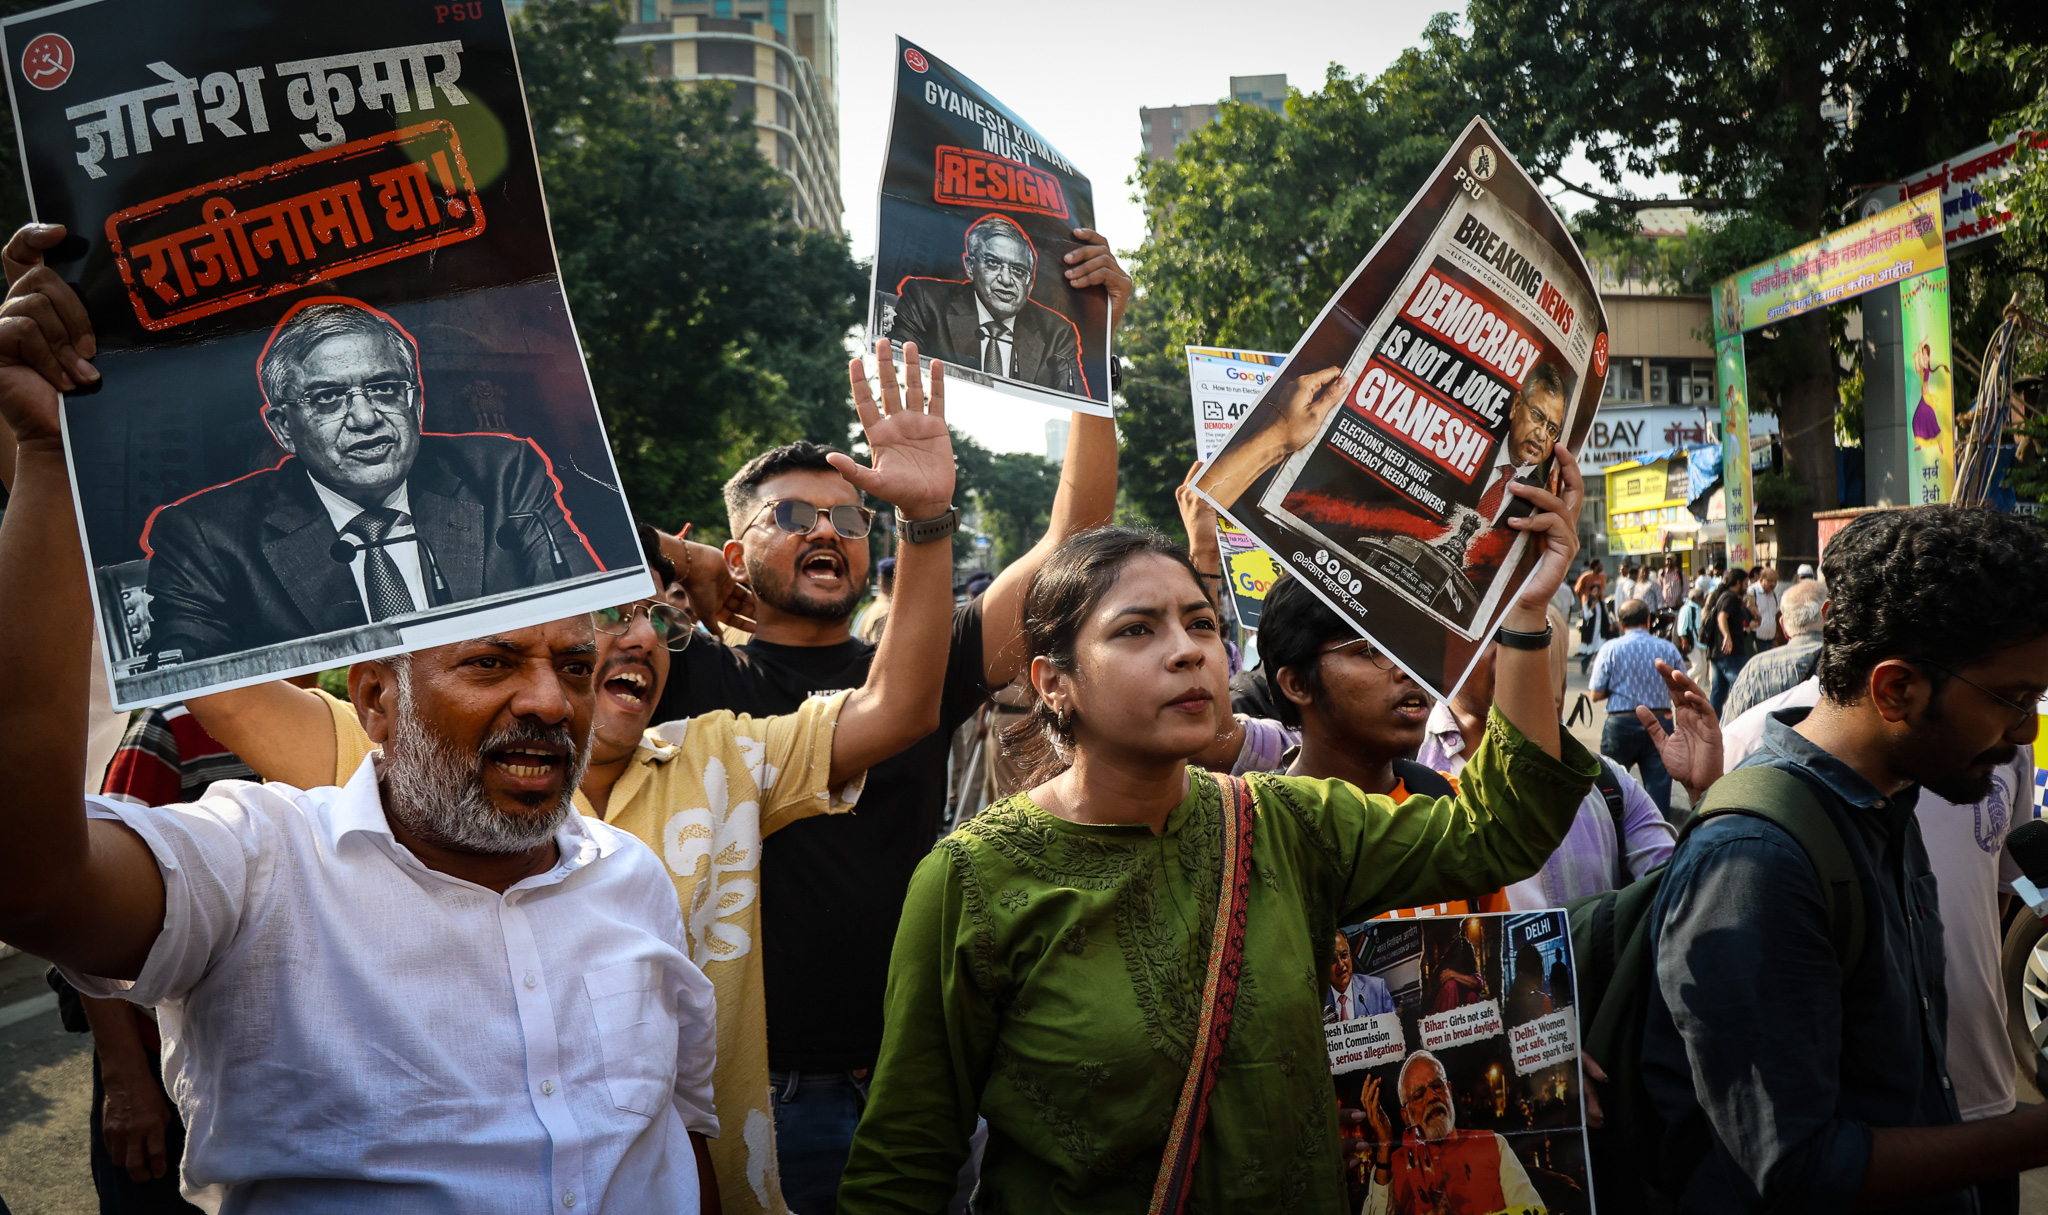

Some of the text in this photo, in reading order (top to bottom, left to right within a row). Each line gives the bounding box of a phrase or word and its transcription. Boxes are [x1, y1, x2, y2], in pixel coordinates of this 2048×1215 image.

[435, 2, 484, 23] PSU
[65, 39, 471, 180] ज्ञानेश कुमार
[925, 80, 1010, 140] GYANESH
[983, 127, 1032, 168] MUST
[943, 154, 1061, 211] RESIGN
[1453, 166, 1485, 200] PSU
[129, 179, 376, 305] राजीनामा
[1453, 212, 1575, 335] BREAKING NEWS
[1483, 273, 1520, 304] COMMISSION
[1521, 303, 1529, 311] OF
[1530, 311, 1545, 326] INDIA
[1767, 300, 1791, 320] आपले
[1815, 284, 1845, 305] स्वागत
[1846, 271, 1875, 295] करीत
[1406, 273, 1541, 385] DEMOCRACY
[1226, 367, 1271, 385] Google
[1380, 325, 1511, 429] IS NOT A JOKE,
[1204, 422, 1235, 430] DEMOCRA
[1355, 366, 1490, 478] GYANESH!
[1588, 420, 1645, 449] BAY
[1338, 417, 1433, 487] ELECTIONS NEED TRUST.
[1594, 450, 1647, 463] MATTRES
[1330, 431, 1447, 515] DEMOCRACY NEEDS ANSWERS.
[1922, 459, 1939, 481] सर्व
[1922, 484, 1940, 504] देवी
[1322, 574, 1352, 605] महाराष्ट्र
[1348, 597, 1368, 618] राज्य
[1525, 917, 1551, 941] DELHI
[1343, 1022, 1368, 1034] Kumar
[1370, 1019, 1378, 1029] in
[1424, 1006, 1494, 1033] Bihar: Girls not safe
[1426, 1019, 1500, 1046] even in broad daylight
[1514, 1018, 1566, 1042] Delhi: Women
[1336, 1051, 1363, 1066] serious
[1364, 1042, 1403, 1060] allegations
[1345, 1031, 1390, 1048] Commission
[1516, 1031, 1568, 1054] not safe, rising
[1518, 1042, 1575, 1067] crimes spark fear
